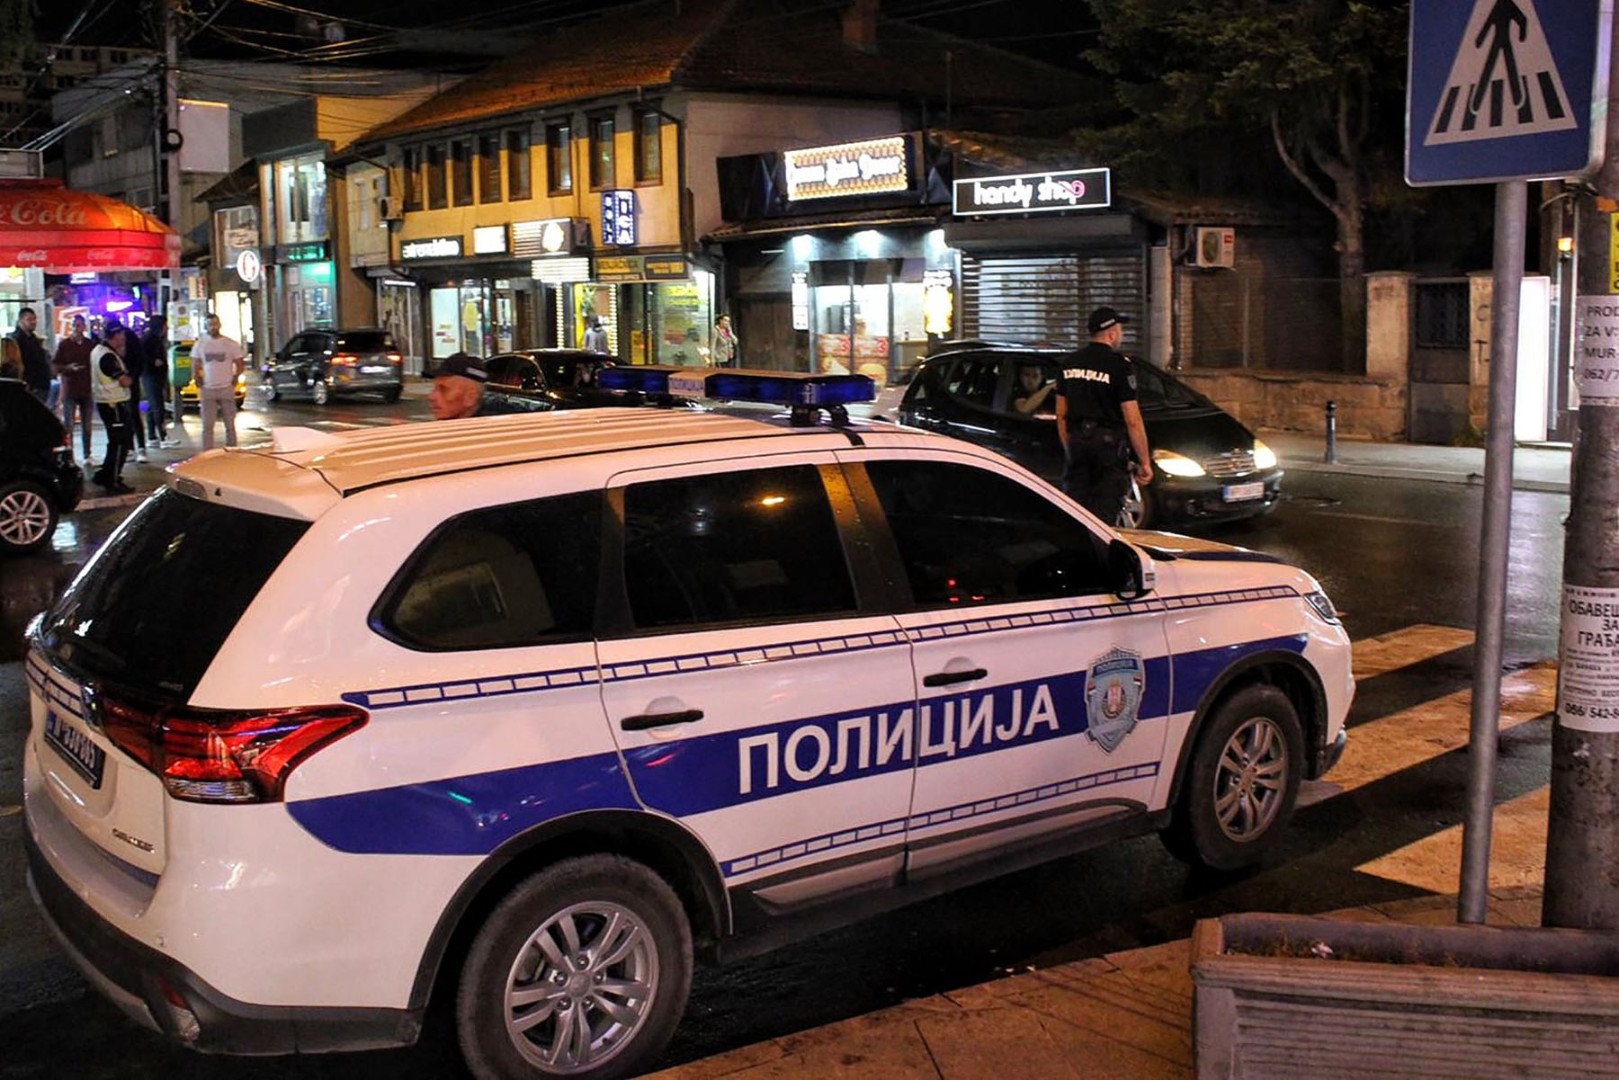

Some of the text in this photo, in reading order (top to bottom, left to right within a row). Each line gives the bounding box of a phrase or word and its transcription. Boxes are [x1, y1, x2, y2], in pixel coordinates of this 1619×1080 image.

[974, 176, 1085, 208] handy shop
[1585, 326, 1601, 337] ZA
[738, 684, 1060, 795] ПОЛИЦИЈА
